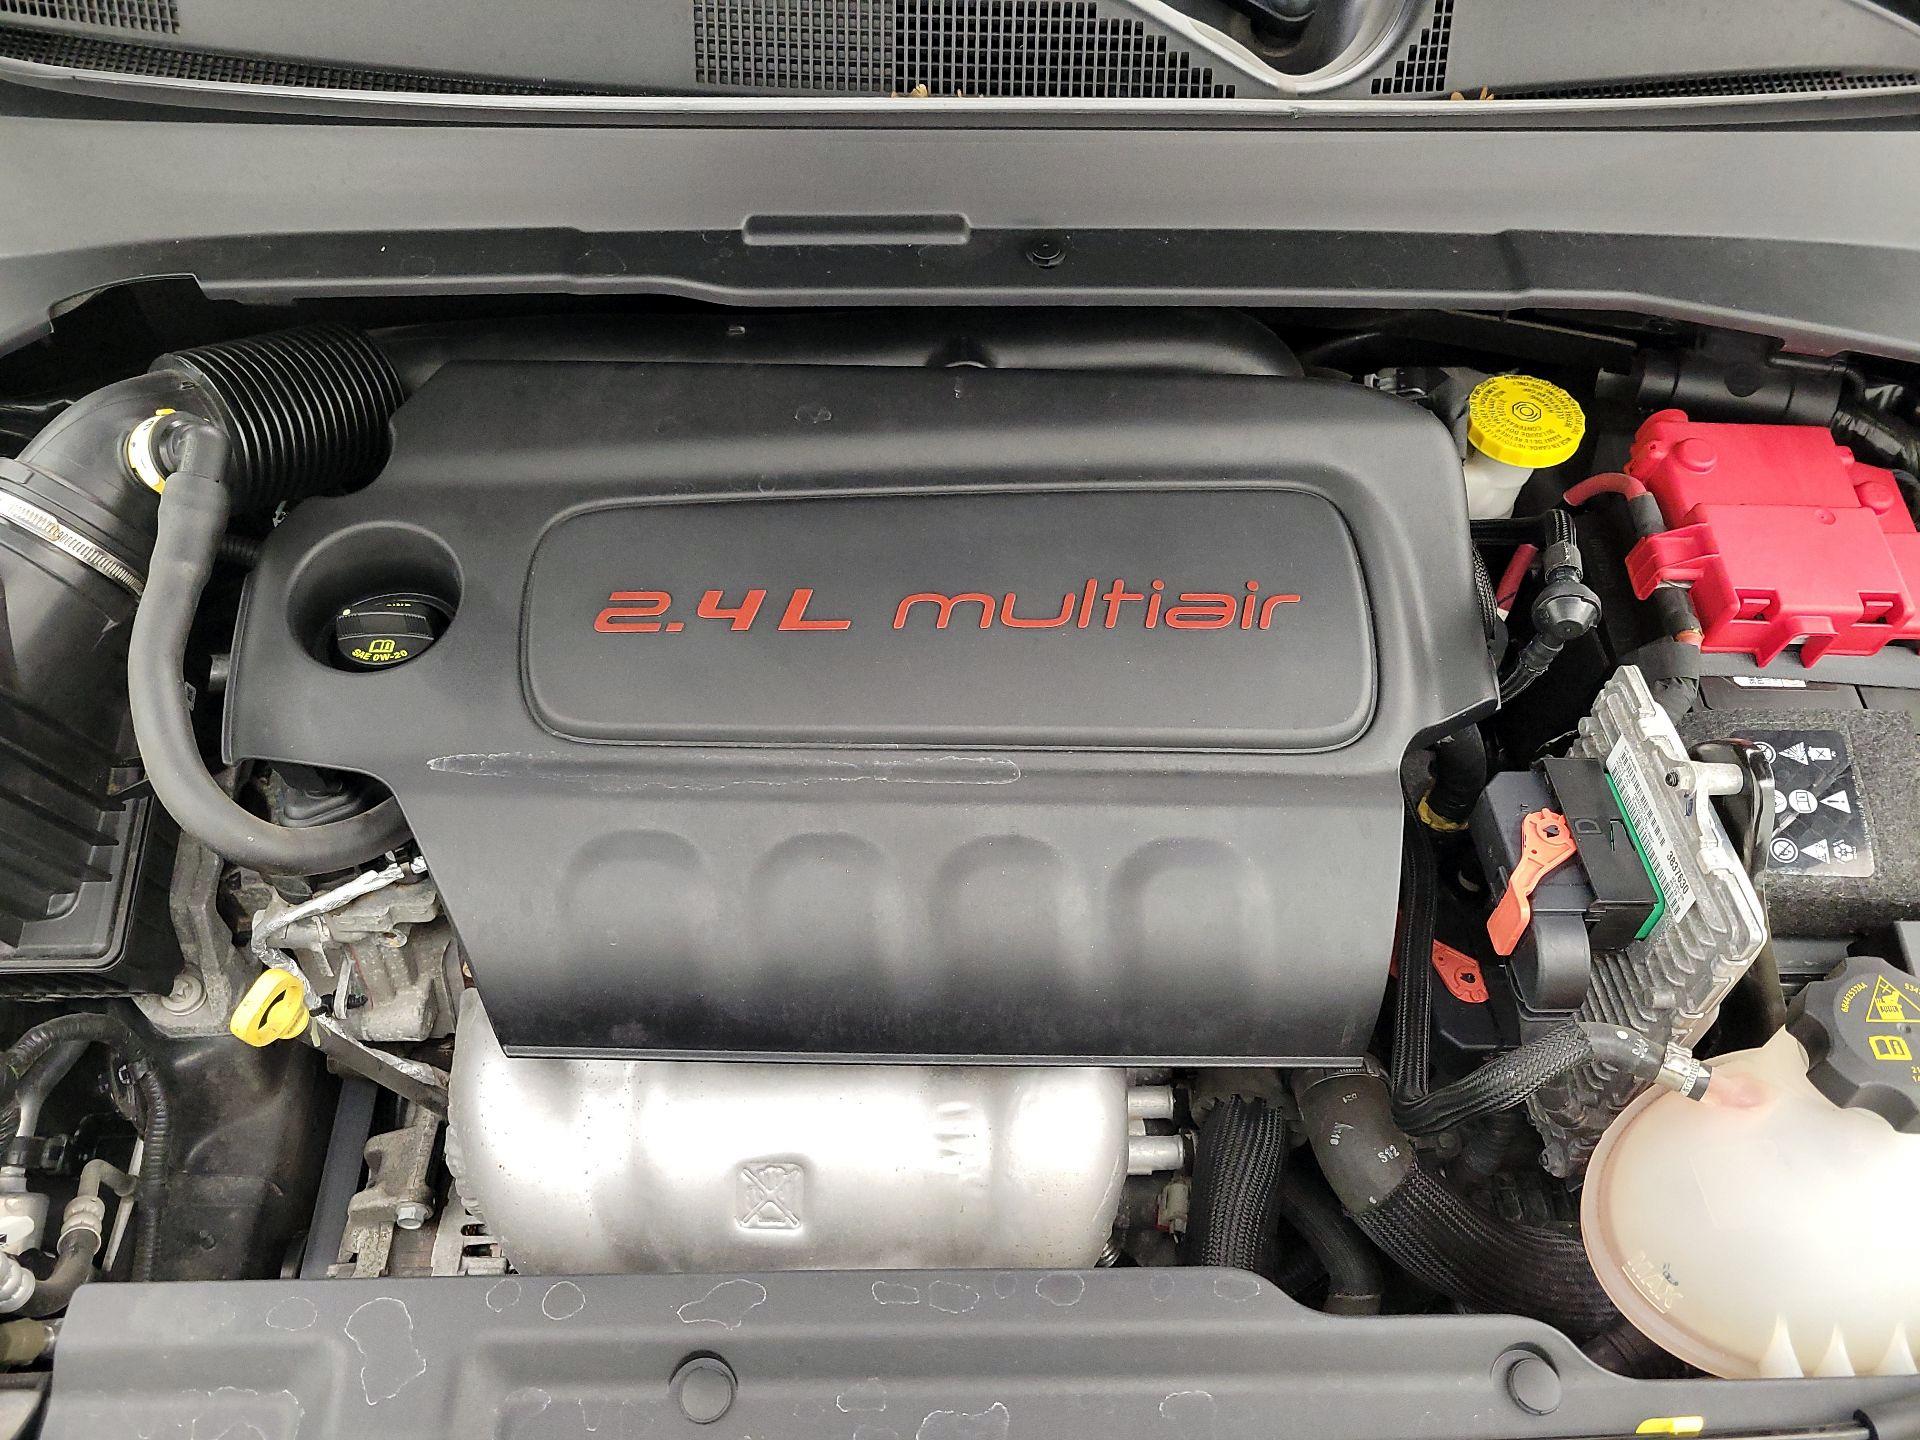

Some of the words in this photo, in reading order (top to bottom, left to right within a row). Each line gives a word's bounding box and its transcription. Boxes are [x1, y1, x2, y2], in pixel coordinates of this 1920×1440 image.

[594, 589, 770, 633] 2.4
[778, 588, 851, 632] L
[893, 578, 1302, 631] multiair
[352, 648, 372, 661] SAE
[373, 649, 408, 661] 0W-20
[1666, 850, 1690, 895] 3837630
[1377, 1144, 1400, 1163] S12
[1626, 1249, 1684, 1309] MAX
